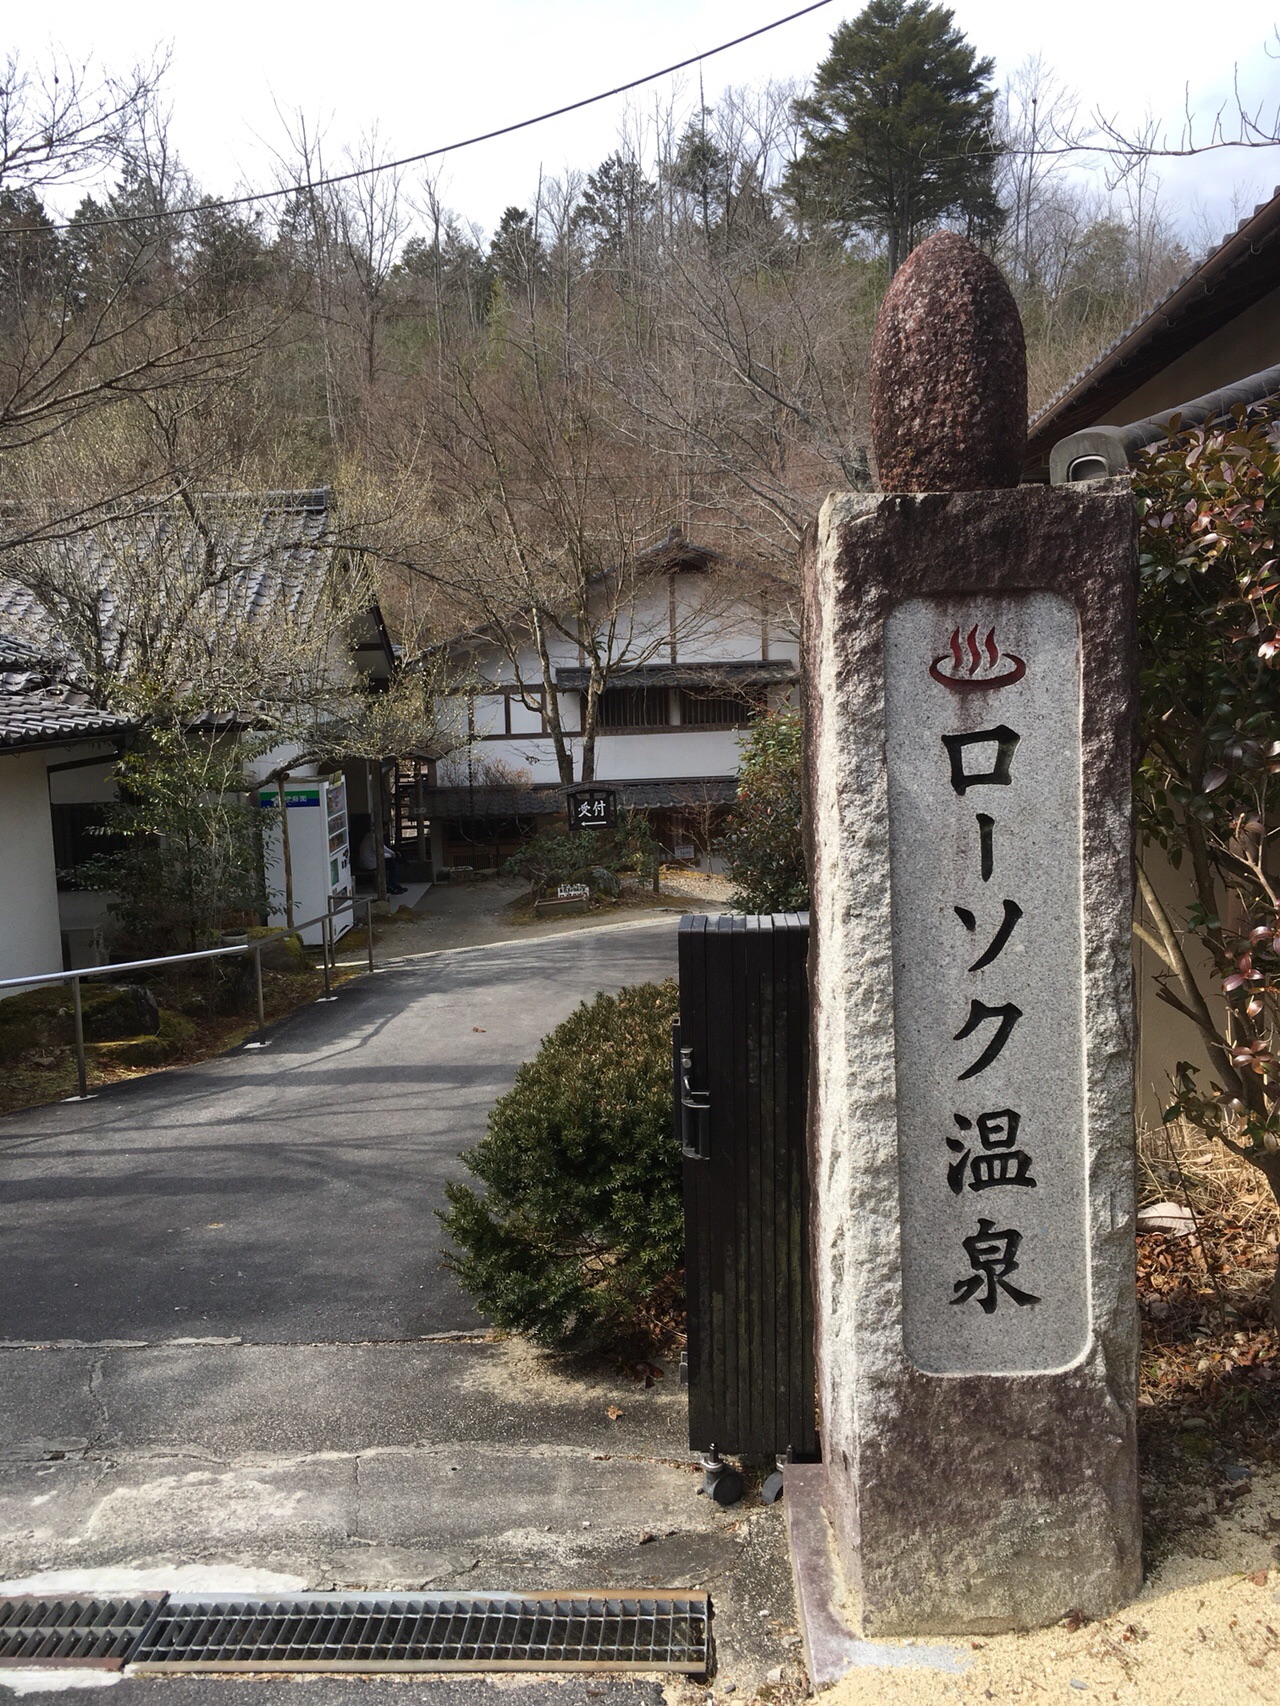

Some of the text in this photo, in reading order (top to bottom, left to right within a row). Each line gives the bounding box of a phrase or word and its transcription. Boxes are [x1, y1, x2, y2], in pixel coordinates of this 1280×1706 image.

[578, 800, 606, 817] 受付
[941, 724, 1042, 1315] ローソク温泉
